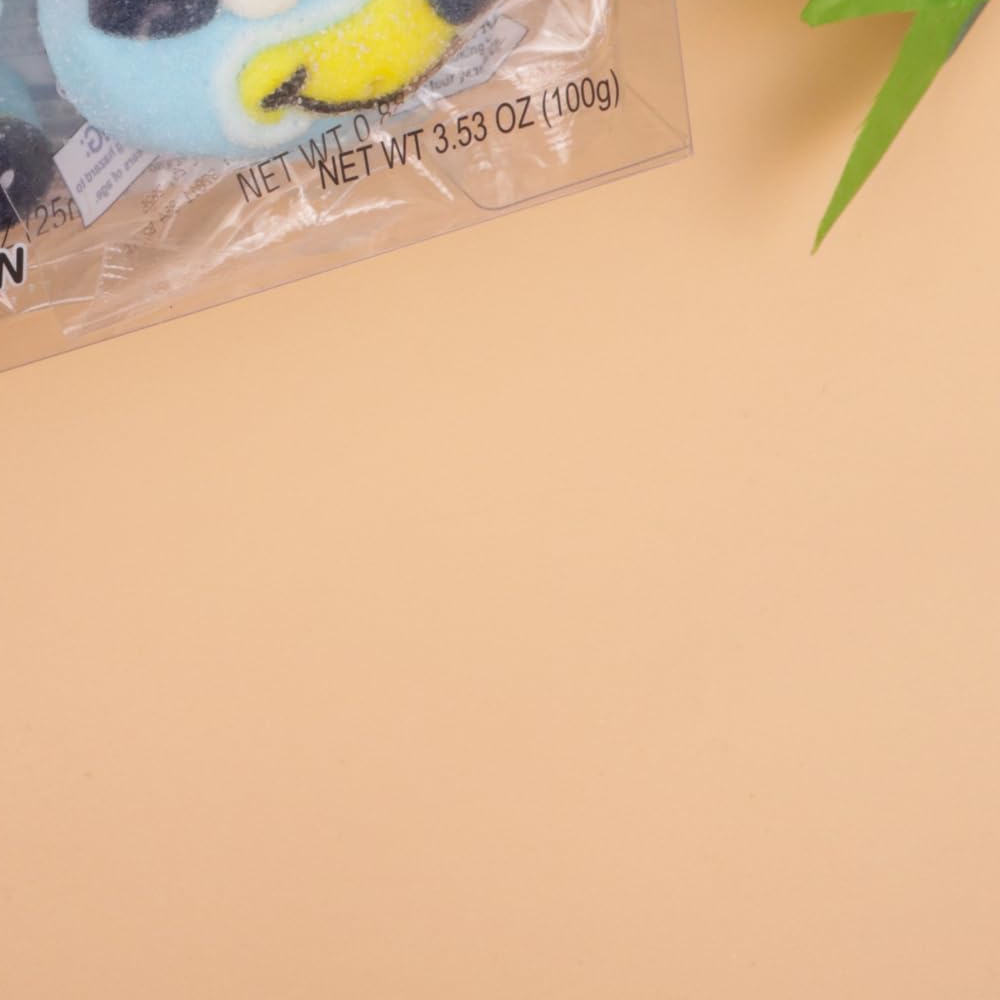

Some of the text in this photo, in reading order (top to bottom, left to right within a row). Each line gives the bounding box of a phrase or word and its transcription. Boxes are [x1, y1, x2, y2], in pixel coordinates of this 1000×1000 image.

[236, 151, 292, 204] NET
[298, 123, 344, 171] WT
[317, 68, 621, 191] NET WT 3.53 OZ (100g)
